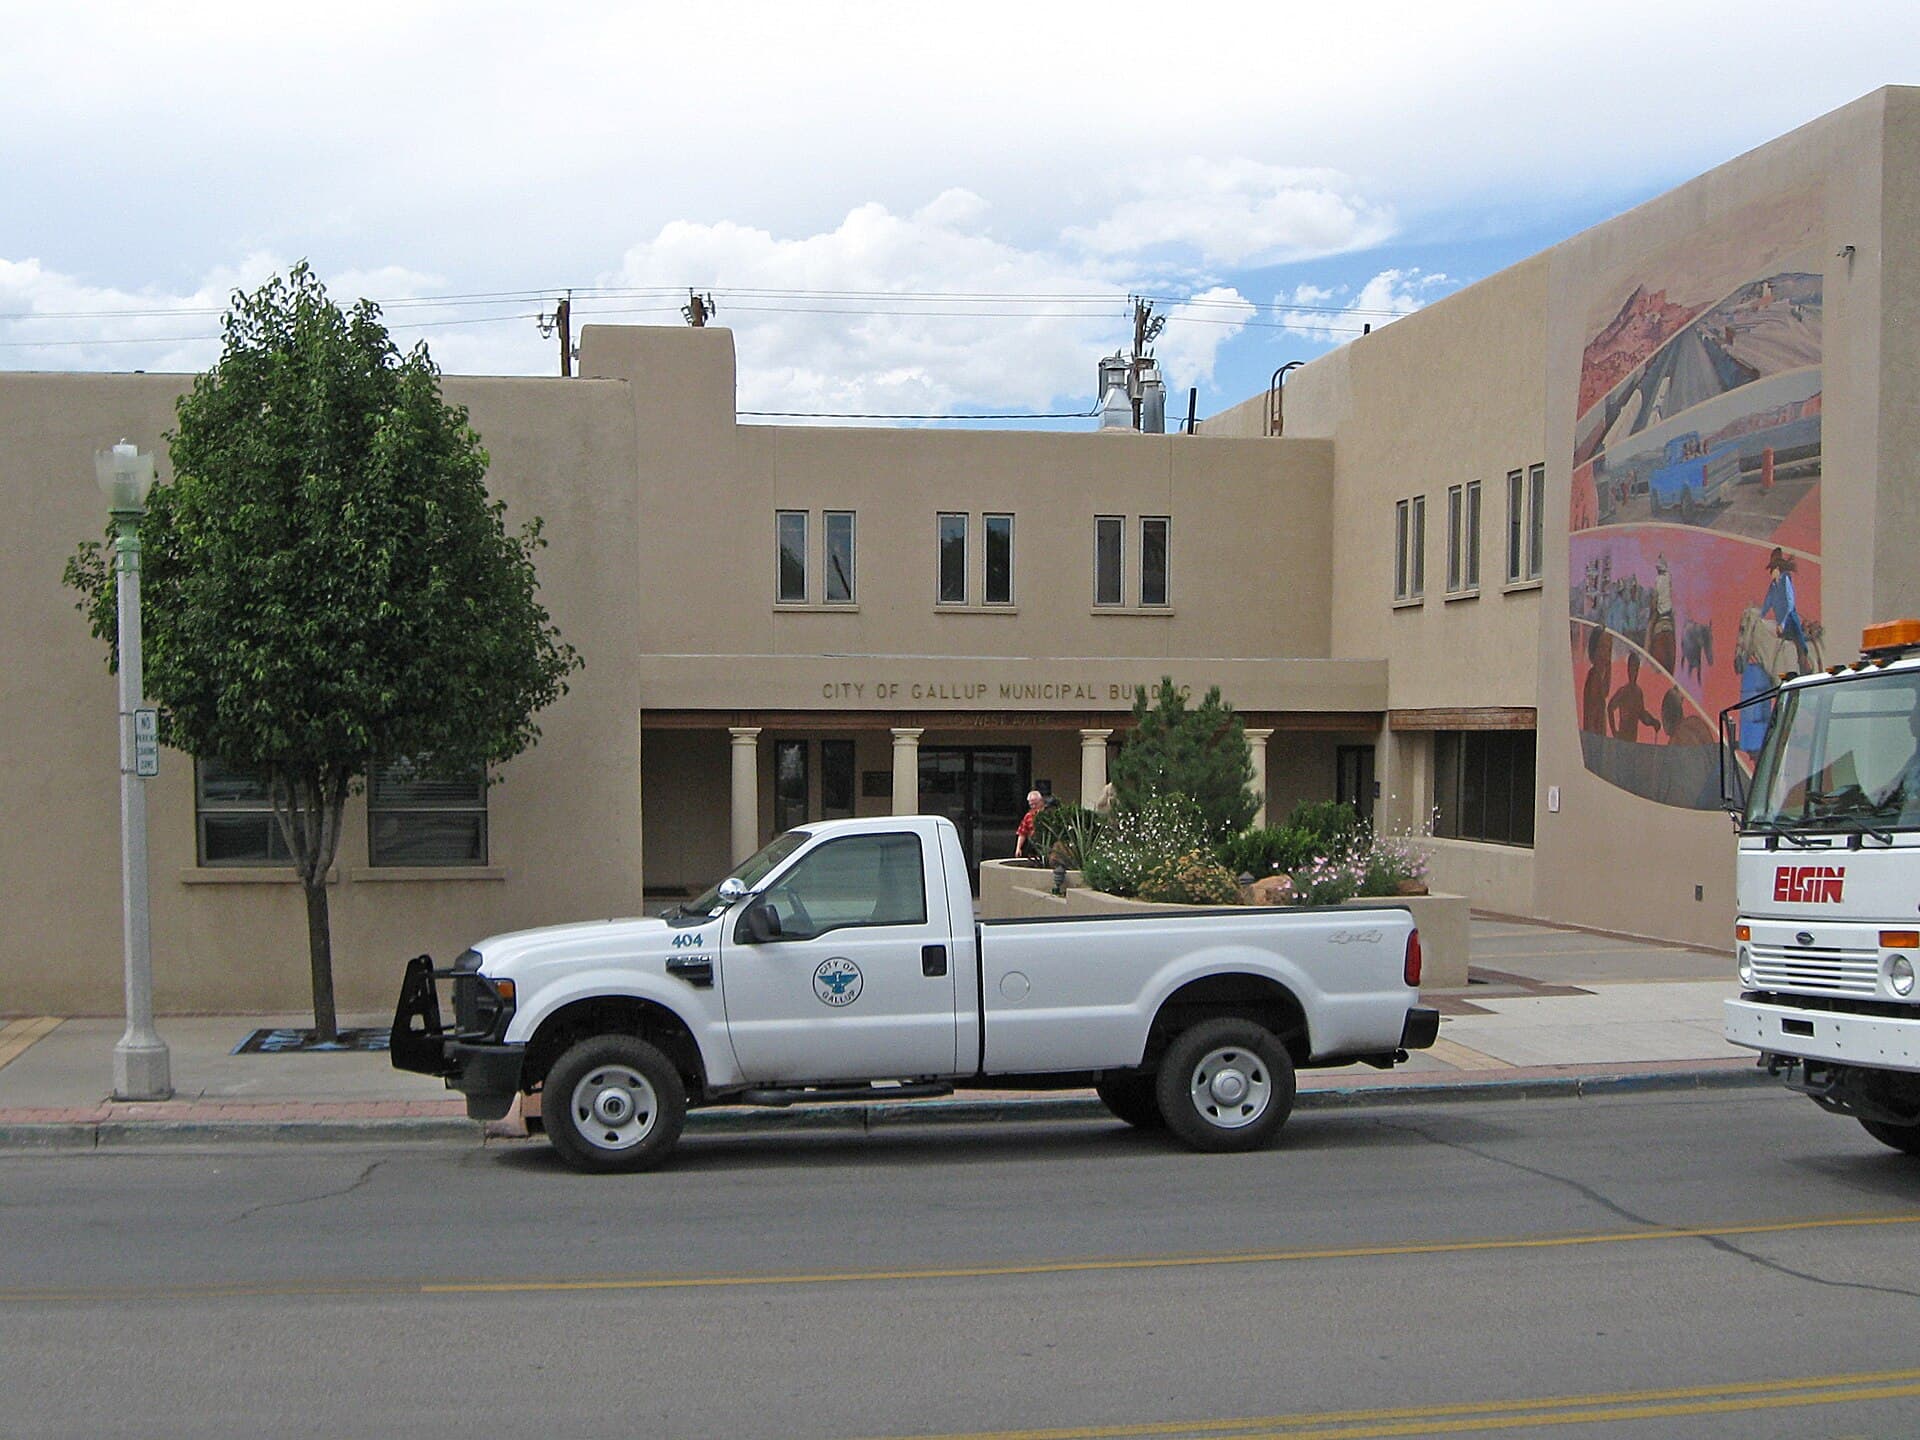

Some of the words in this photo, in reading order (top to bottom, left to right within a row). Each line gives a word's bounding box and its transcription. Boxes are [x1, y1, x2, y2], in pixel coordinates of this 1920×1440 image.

[822, 683, 864, 699] CITY
[876, 683, 899, 699] OF
[911, 683, 987, 700] GALLUP
[999, 683, 1097, 700] MUNICIPAL
[1773, 866, 1845, 903] ELGIN
[671, 933, 704, 949] 404
[819, 960, 838, 975] CITY
[843, 962, 855, 972] OF
[822, 990, 855, 1004] GALLUP
